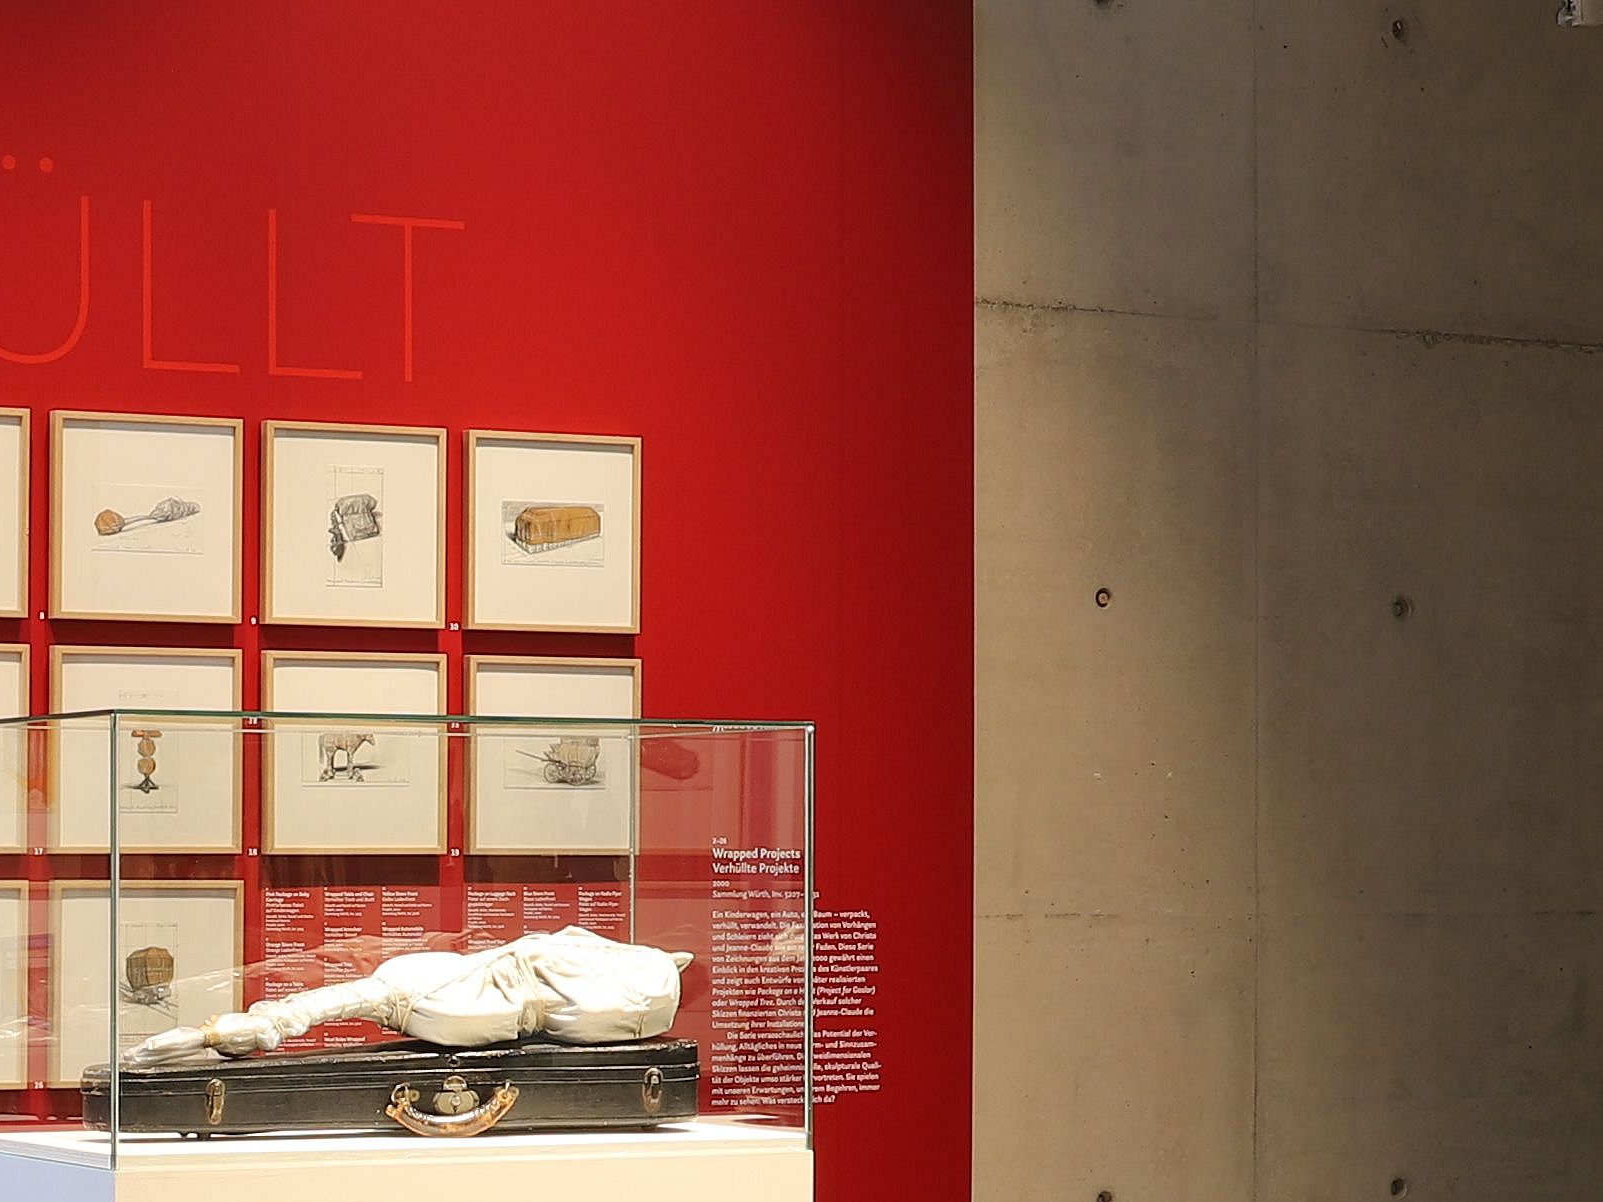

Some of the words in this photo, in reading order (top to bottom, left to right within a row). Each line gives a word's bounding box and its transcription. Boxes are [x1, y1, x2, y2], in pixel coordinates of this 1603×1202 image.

[712, 848, 758, 861] Wrapped
[760, 848, 801, 861] Projects
[712, 862, 757, 874] Verhüllte
[759, 863, 800, 876] Projekte
